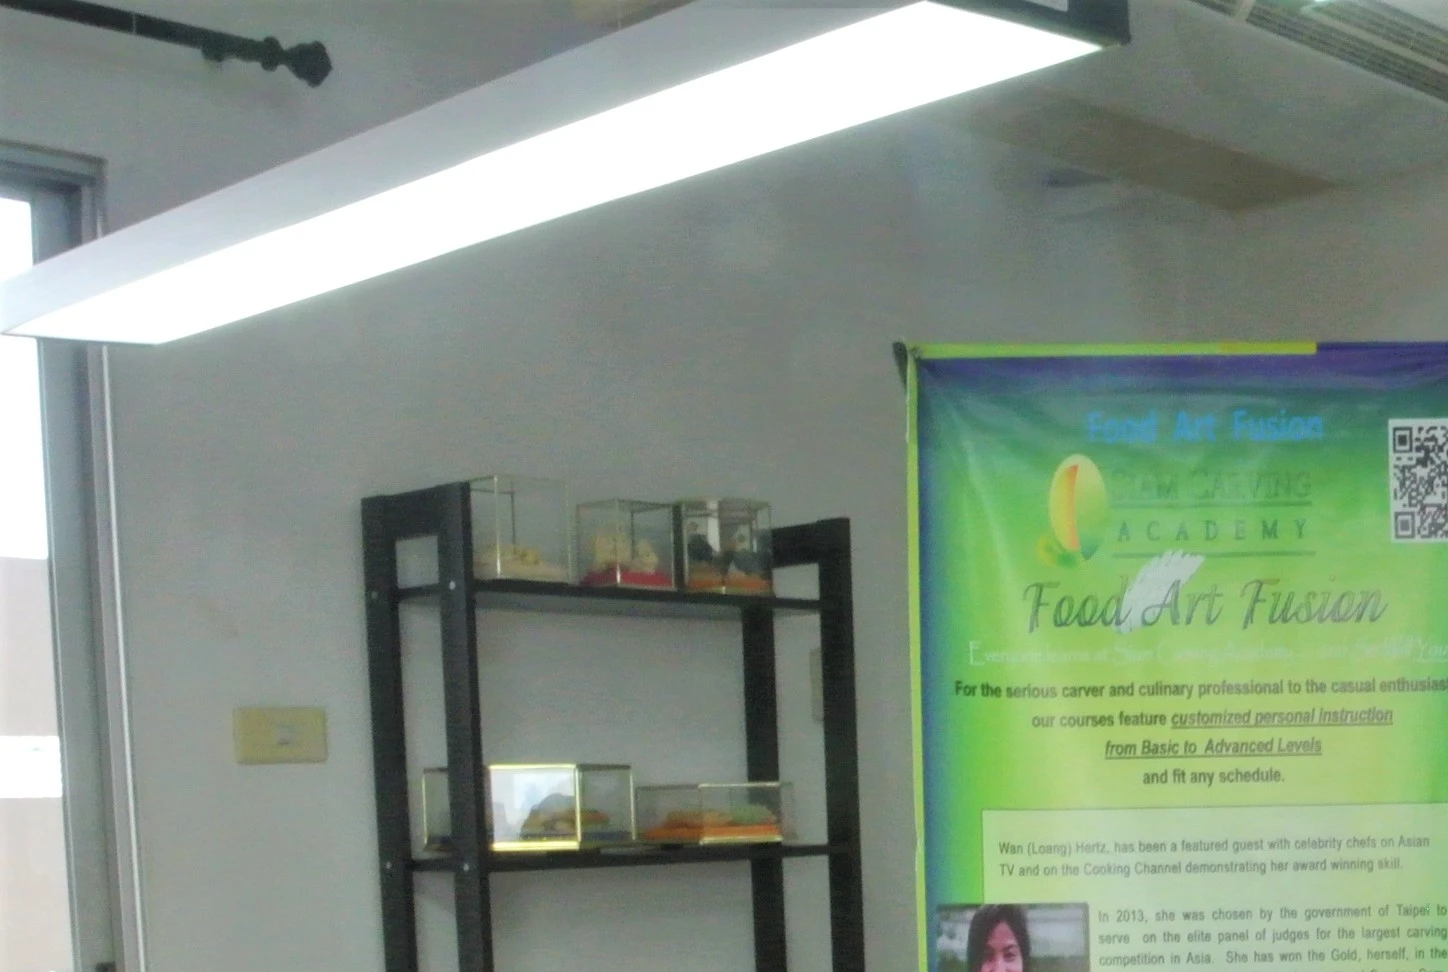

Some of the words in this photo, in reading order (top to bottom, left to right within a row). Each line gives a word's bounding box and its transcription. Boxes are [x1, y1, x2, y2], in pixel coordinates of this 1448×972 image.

[1086, 410, 1157, 445] Food
[1173, 409, 1215, 443] Art
[1231, 406, 1324, 443] Fusion
[1117, 518, 1307, 542] ACADEMY
[1023, 575, 1132, 634] Food
[1133, 579, 1223, 628] Art
[1239, 574, 1388, 630] Fusion
[954, 679, 977, 697] For
[980, 681, 1002, 698] the
[1005, 682, 1057, 699] serious
[1061, 684, 1105, 698] carver
[1109, 681, 1134, 697] and
[1138, 680, 1193, 701] culinary
[1197, 678, 1283, 699] professional
[1287, 679, 1301, 694] to
[1304, 678, 1326, 694] the
[1330, 677, 1375, 693] casual
[1031, 714, 1055, 728] our
[1059, 713, 1114, 728] courses
[1118, 708, 1167, 726] feature
[1170, 708, 1251, 730] customized
[1254, 706, 1315, 728] personal
[1318, 705, 1392, 727] instruction
[1104, 739, 1136, 760] from
[1141, 738, 1179, 759] Basic
[1183, 739, 1197, 758] to
[1204, 736, 1274, 758] Advanced
[1277, 736, 1322, 757] Levels
[1143, 768, 1168, 784] and
[1172, 767, 1186, 784] fit
[1190, 770, 1214, 788] any
[1218, 766, 1285, 783] schedule.
[998, 840, 1023, 855] Wan
[1113, 840, 1134, 853] has
[1138, 839, 1166, 853] been
[1180, 838, 1228, 852] featured
[1231, 838, 1263, 854] guest
[1268, 836, 1290, 850] with
[1293, 836, 1342, 852] celebrity
[1345, 834, 1376, 849] chefs
[1397, 833, 1429, 848] Asian
[999, 862, 1014, 876] TV
[1018, 863, 1039, 877] and
[1061, 863, 1079, 876] the
[1083, 861, 1130, 879] Cooking
[1134, 860, 1181, 875] Channel
[1184, 858, 1266, 877] demonstrating
[1270, 858, 1288, 872] her
[1292, 857, 1327, 872] award
[1330, 858, 1373, 874] winning
[1378, 856, 1404, 870] skill.
[1115, 908, 1149, 924] 2013,
[1154, 908, 1176, 922] she
[1181, 910, 1205, 921] was
[1210, 906, 1253, 921] chosen
[1278, 905, 1298, 919] the
[1303, 904, 1372, 922] government
[1395, 902, 1431, 919] Taipei
[1097, 933, 1130, 945] serve
[1161, 930, 1181, 943] the
[1186, 929, 1212, 943] elite
[1216, 928, 1249, 945] panel
[1271, 927, 1310, 944] judges
[1315, 926, 1331, 940] for
[1336, 926, 1356, 940] the
[1360, 925, 1401, 942] largest
[1405, 925, 1448, 941] carving
[1098, 952, 1165, 968] competition
[1185, 950, 1214, 964] Asia.
[1225, 949, 1248, 964] She
[1252, 949, 1274, 963] has
[1278, 951, 1302, 962] won
[1306, 948, 1326, 962] the
[1330, 946, 1362, 962] Gold,
[1365, 946, 1409, 961] herself,
[1414, 946, 1425, 959] in
[1429, 946, 1448, 960] the
